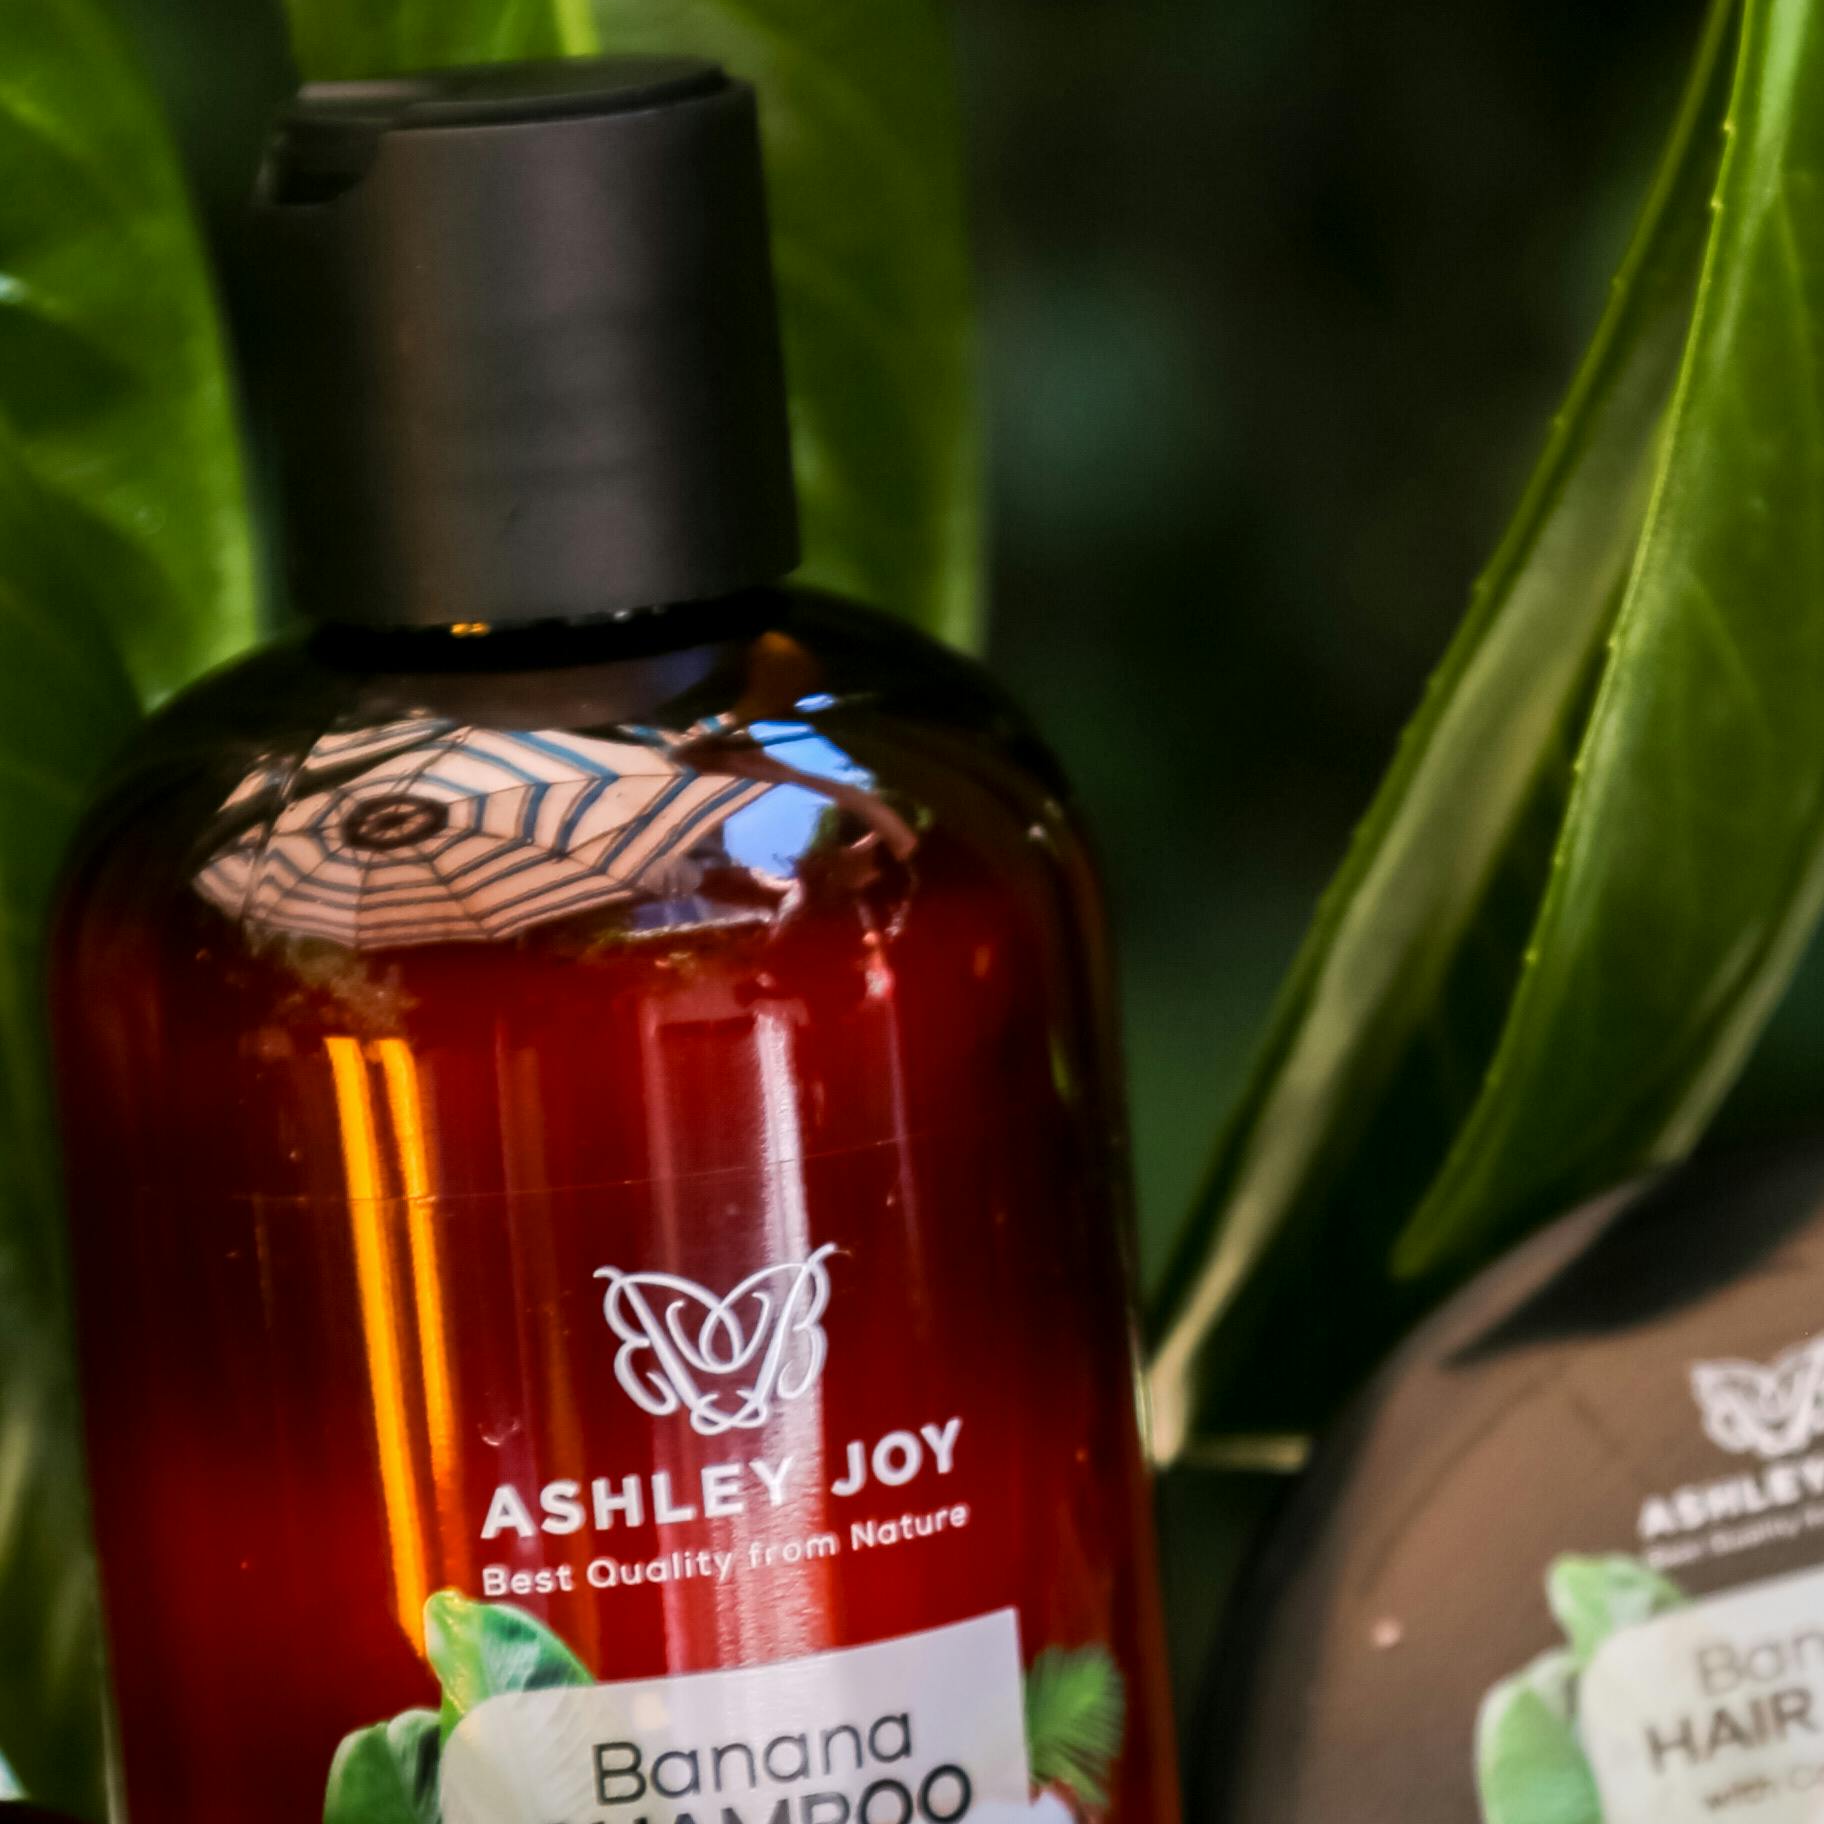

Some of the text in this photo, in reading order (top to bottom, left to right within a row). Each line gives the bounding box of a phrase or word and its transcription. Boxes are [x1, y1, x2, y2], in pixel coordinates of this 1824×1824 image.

[481, 1417, 963, 1539] ASHLEY JOY
[482, 1504, 970, 1597] Best Quality from Nature
[592, 1711, 912, 1806] Banana
[1643, 1687, 1814, 1774] HAIR
